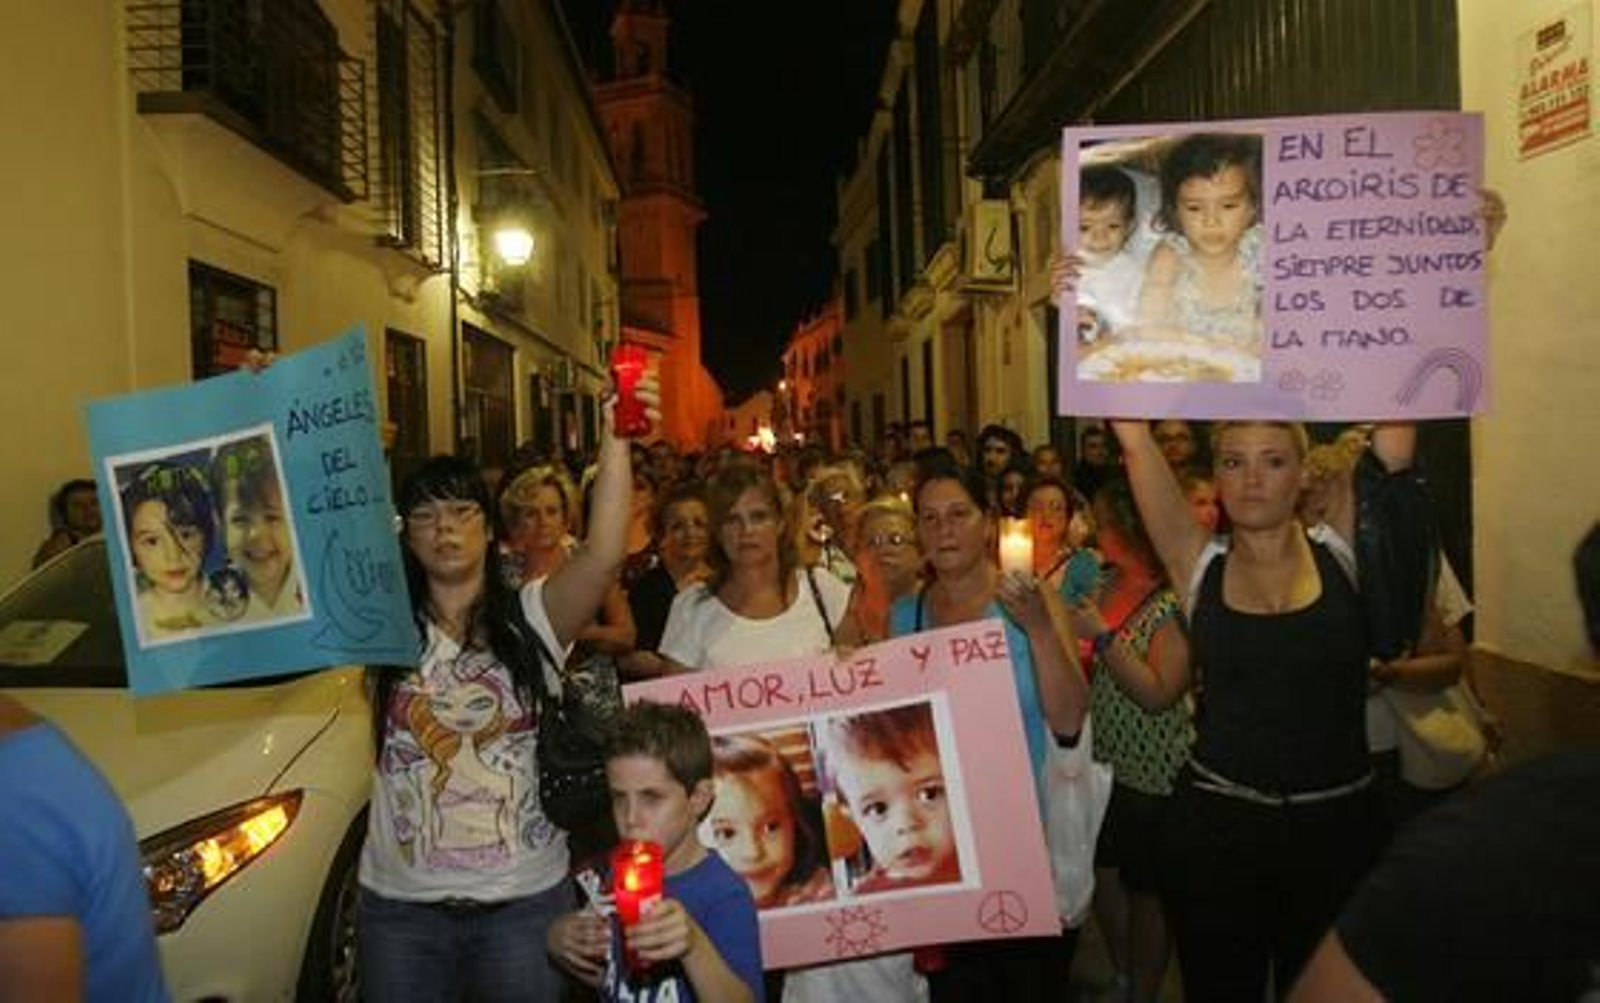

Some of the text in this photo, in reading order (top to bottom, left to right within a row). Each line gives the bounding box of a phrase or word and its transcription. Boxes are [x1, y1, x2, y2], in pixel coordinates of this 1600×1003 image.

[1278, 126, 1393, 162] EN EL
[1431, 173, 1468, 199] DE
[1274, 222, 1308, 243] LA
[1386, 250, 1483, 275] JUNTOS
[1275, 286, 1476, 312] LOS DOS DE
[1272, 330, 1303, 349] LA
[321, 447, 357, 478] DEL
[910, 644, 931, 671] Y
[949, 631, 1009, 666] PAZ
